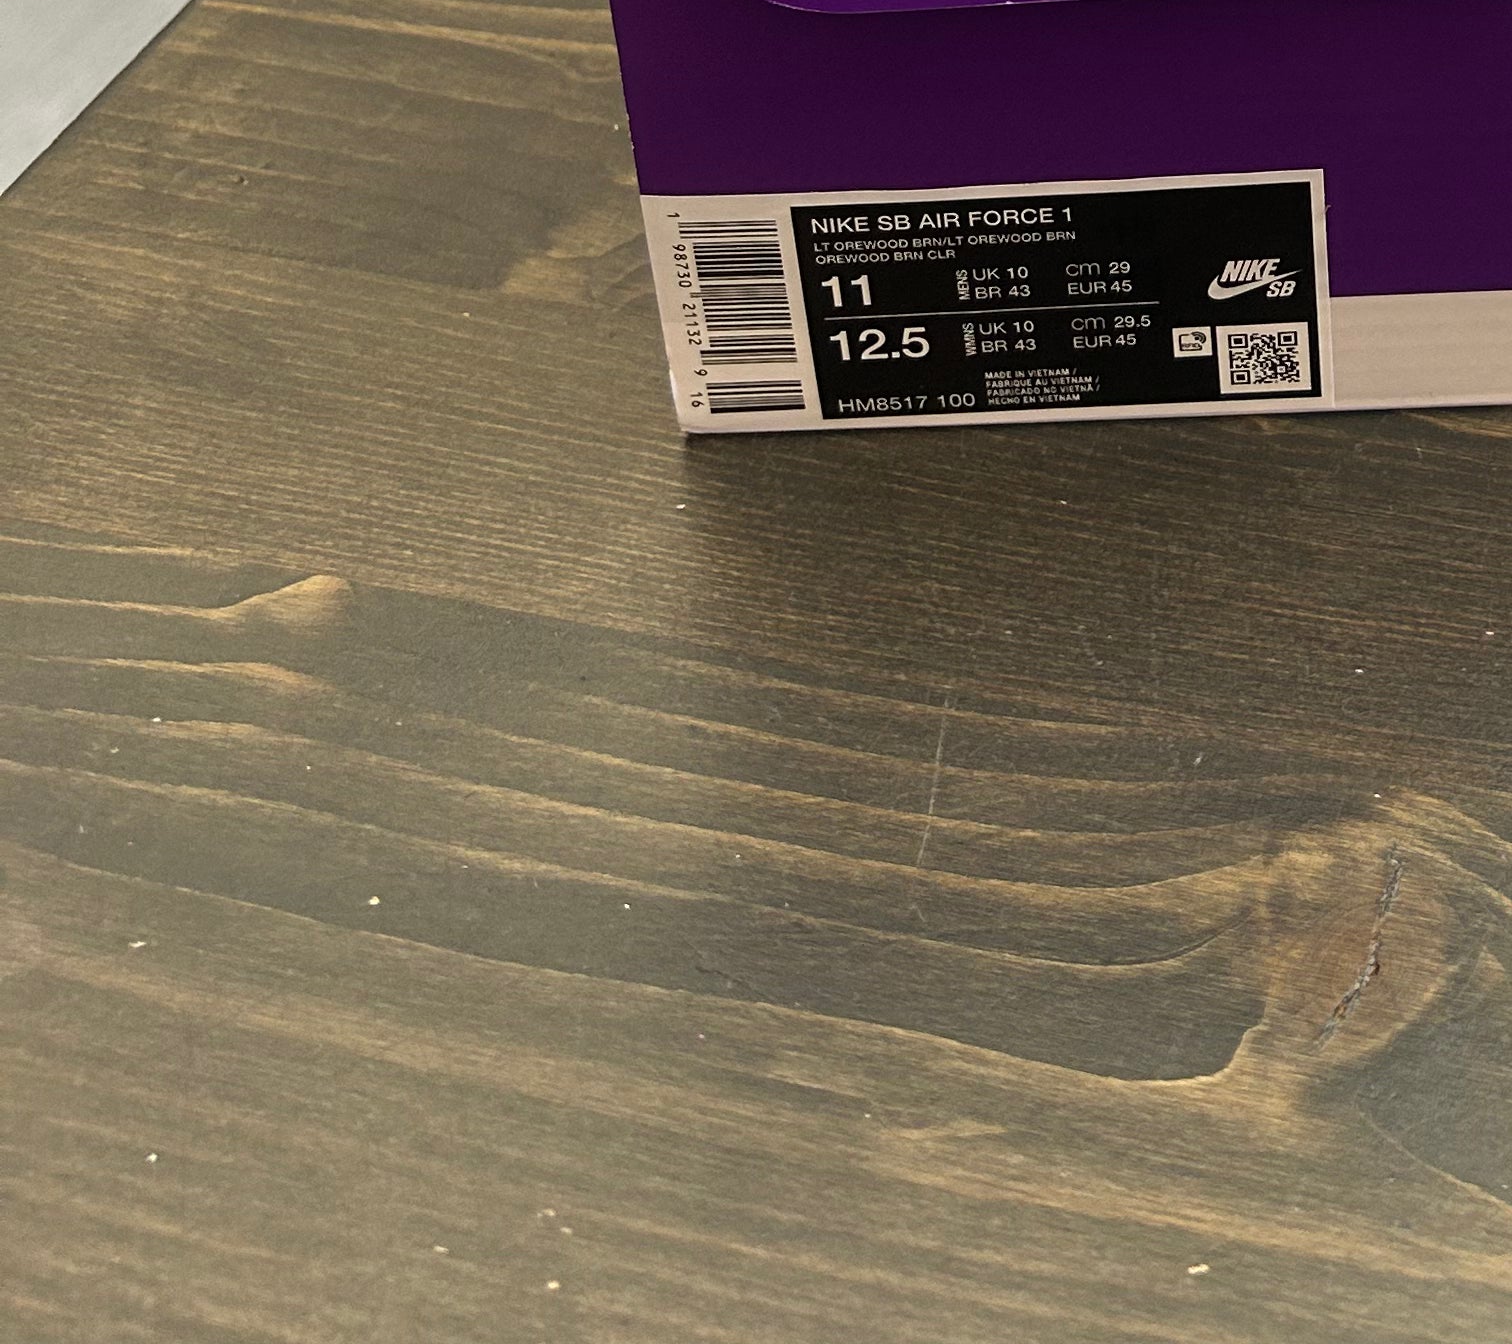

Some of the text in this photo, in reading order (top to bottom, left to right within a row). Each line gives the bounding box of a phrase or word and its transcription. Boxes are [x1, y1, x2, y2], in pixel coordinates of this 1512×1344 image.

[811, 207, 1073, 234] NIKE SB AIR FORCE 1
[814, 230, 1076, 252] LT OREWOOD BRN/LT OREWOOD BRN
[815, 249, 957, 265] OREWOOD BRN CLR
[973, 266, 1029, 282] UK 10
[1066, 261, 1131, 277] cm 29
[1219, 258, 1281, 283] NIKE
[821, 274, 872, 308] 11
[955, 269, 970, 301] MENS
[975, 284, 1031, 300] BR 43
[1067, 279, 1133, 295] EUR 45
[1266, 280, 1297, 298] SB
[671, 243, 693, 289] 98730
[682, 302, 703, 346] 21132
[693, 368, 708, 377] 9
[979, 320, 1035, 335] UK 10
[1071, 315, 1151, 331] cm 29.5
[829, 326, 931, 362] 12.5
[962, 322, 977, 357] WMNS
[981, 338, 1037, 353] BR 43
[1073, 333, 1137, 349] EUR 45
[984, 370, 1012, 379] MADE
[1015, 370, 1025, 378] IN
[1027, 368, 1070, 378] VIETNAM
[1035, 378, 1048, 386] AU
[1050, 376, 1093, 385] VIETNAM
[690, 391, 705, 408] 16
[838, 392, 976, 413] HM8517 100
[1023, 395, 1036, 404] EN
[1039, 393, 1081, 403] VIETNAM
